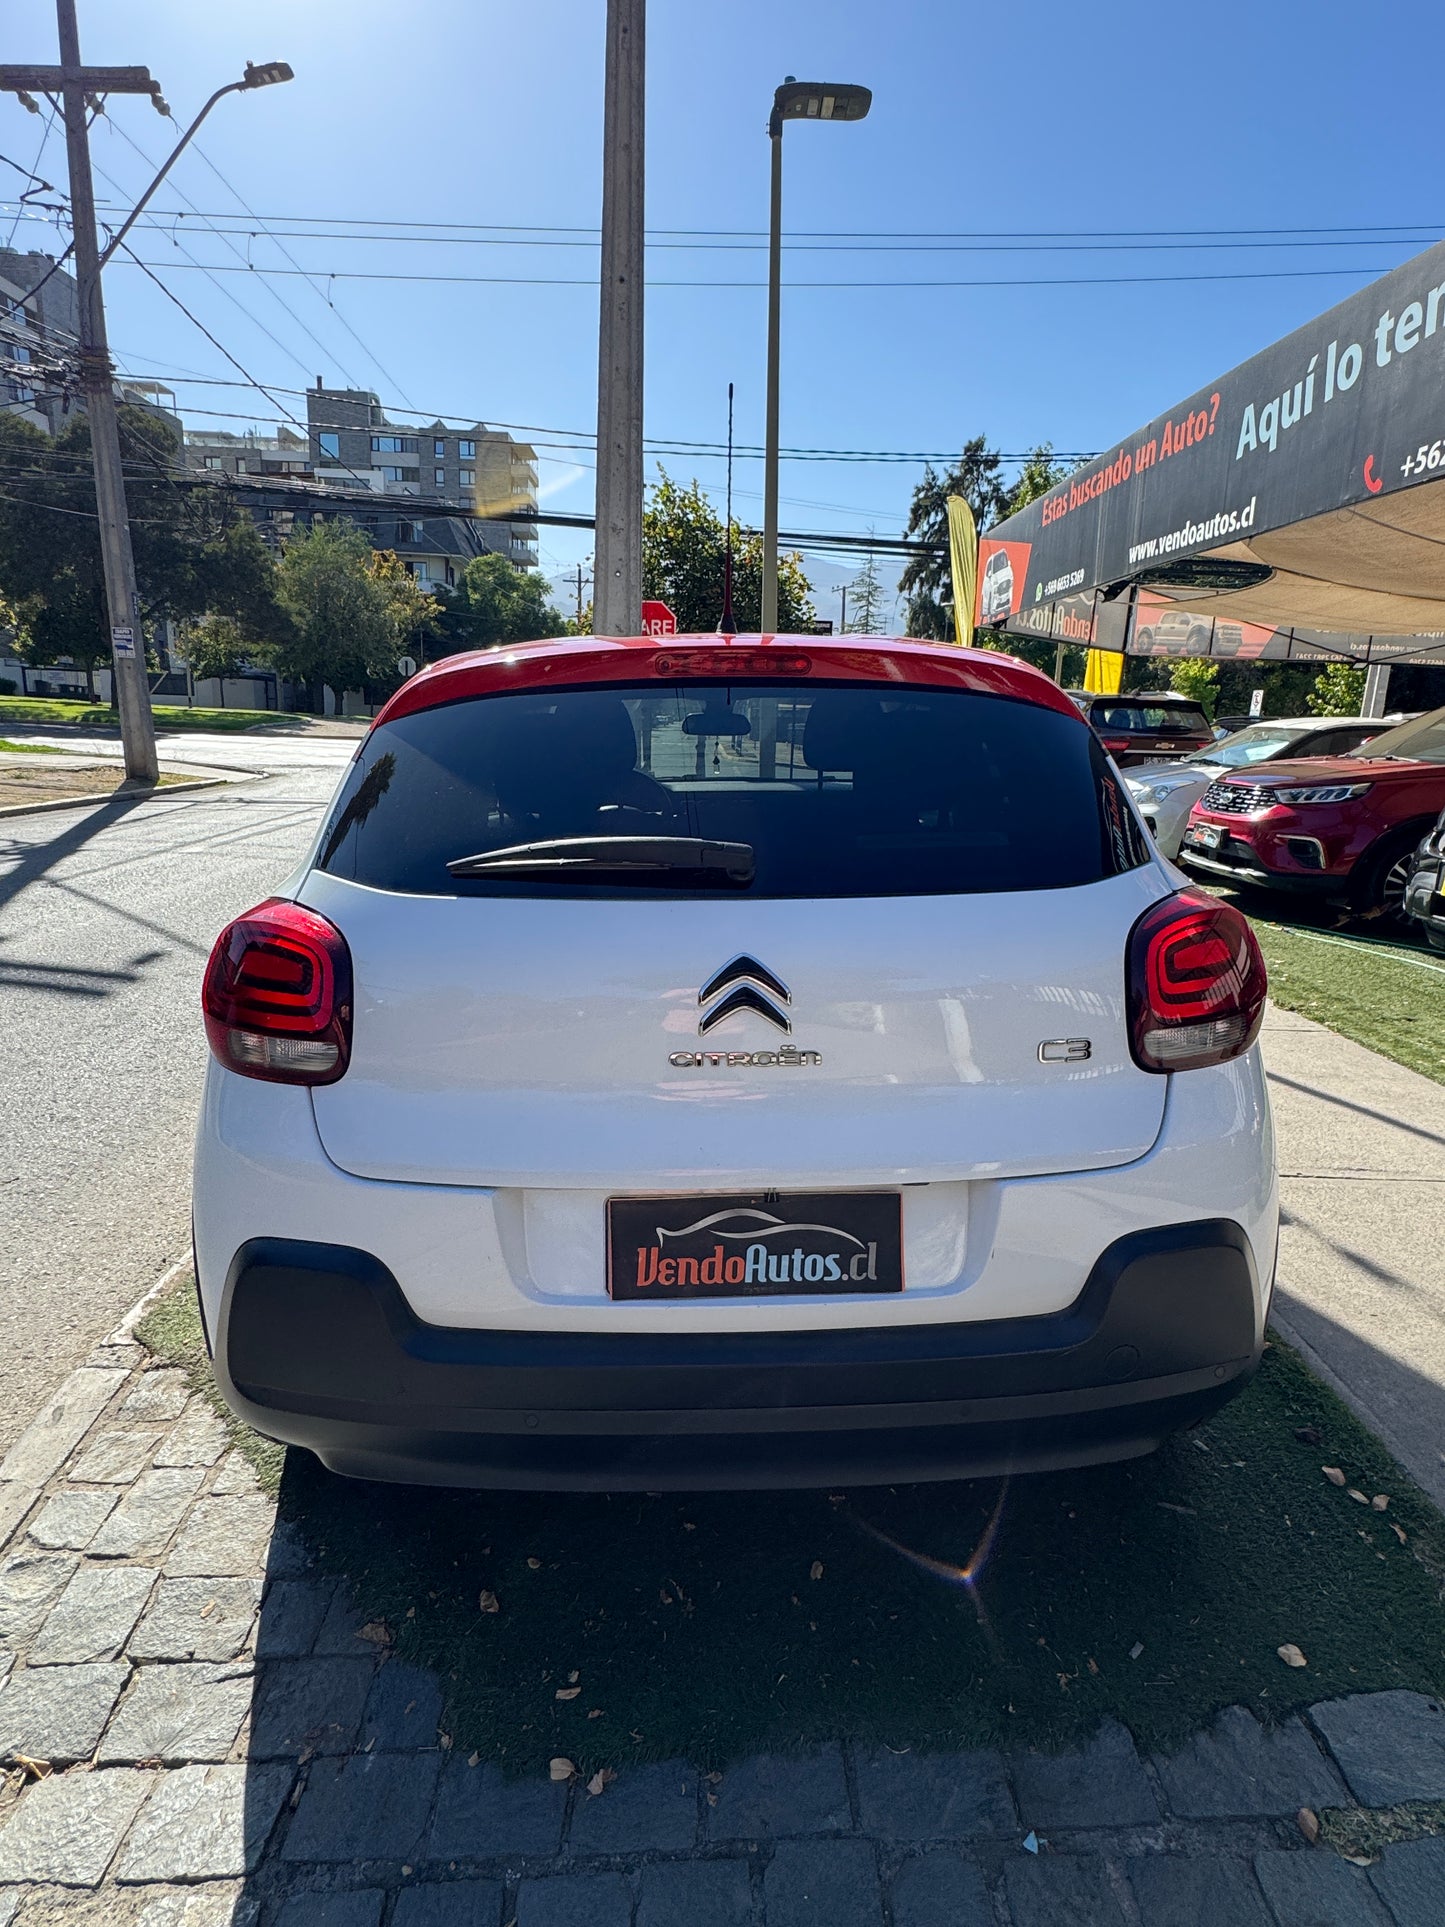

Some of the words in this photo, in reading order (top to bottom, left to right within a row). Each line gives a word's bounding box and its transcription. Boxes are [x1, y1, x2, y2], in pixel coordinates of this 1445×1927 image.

[1236, 354, 1319, 460] Aquí
[1324, 340, 1362, 403] lo
[1042, 492, 1068, 527] Estas
[1069, 449, 1132, 511] buscando
[1135, 439, 1157, 474] un
[1159, 392, 1220, 461] Auto?
[1129, 496, 1256, 564] www.vendoautos.cl
[642, 619, 673, 636] ARE
[669, 1044, 822, 1067] CITROËN
[1037, 1037, 1092, 1064] C3
[637, 1242, 877, 1287] VendoAutos.cl
